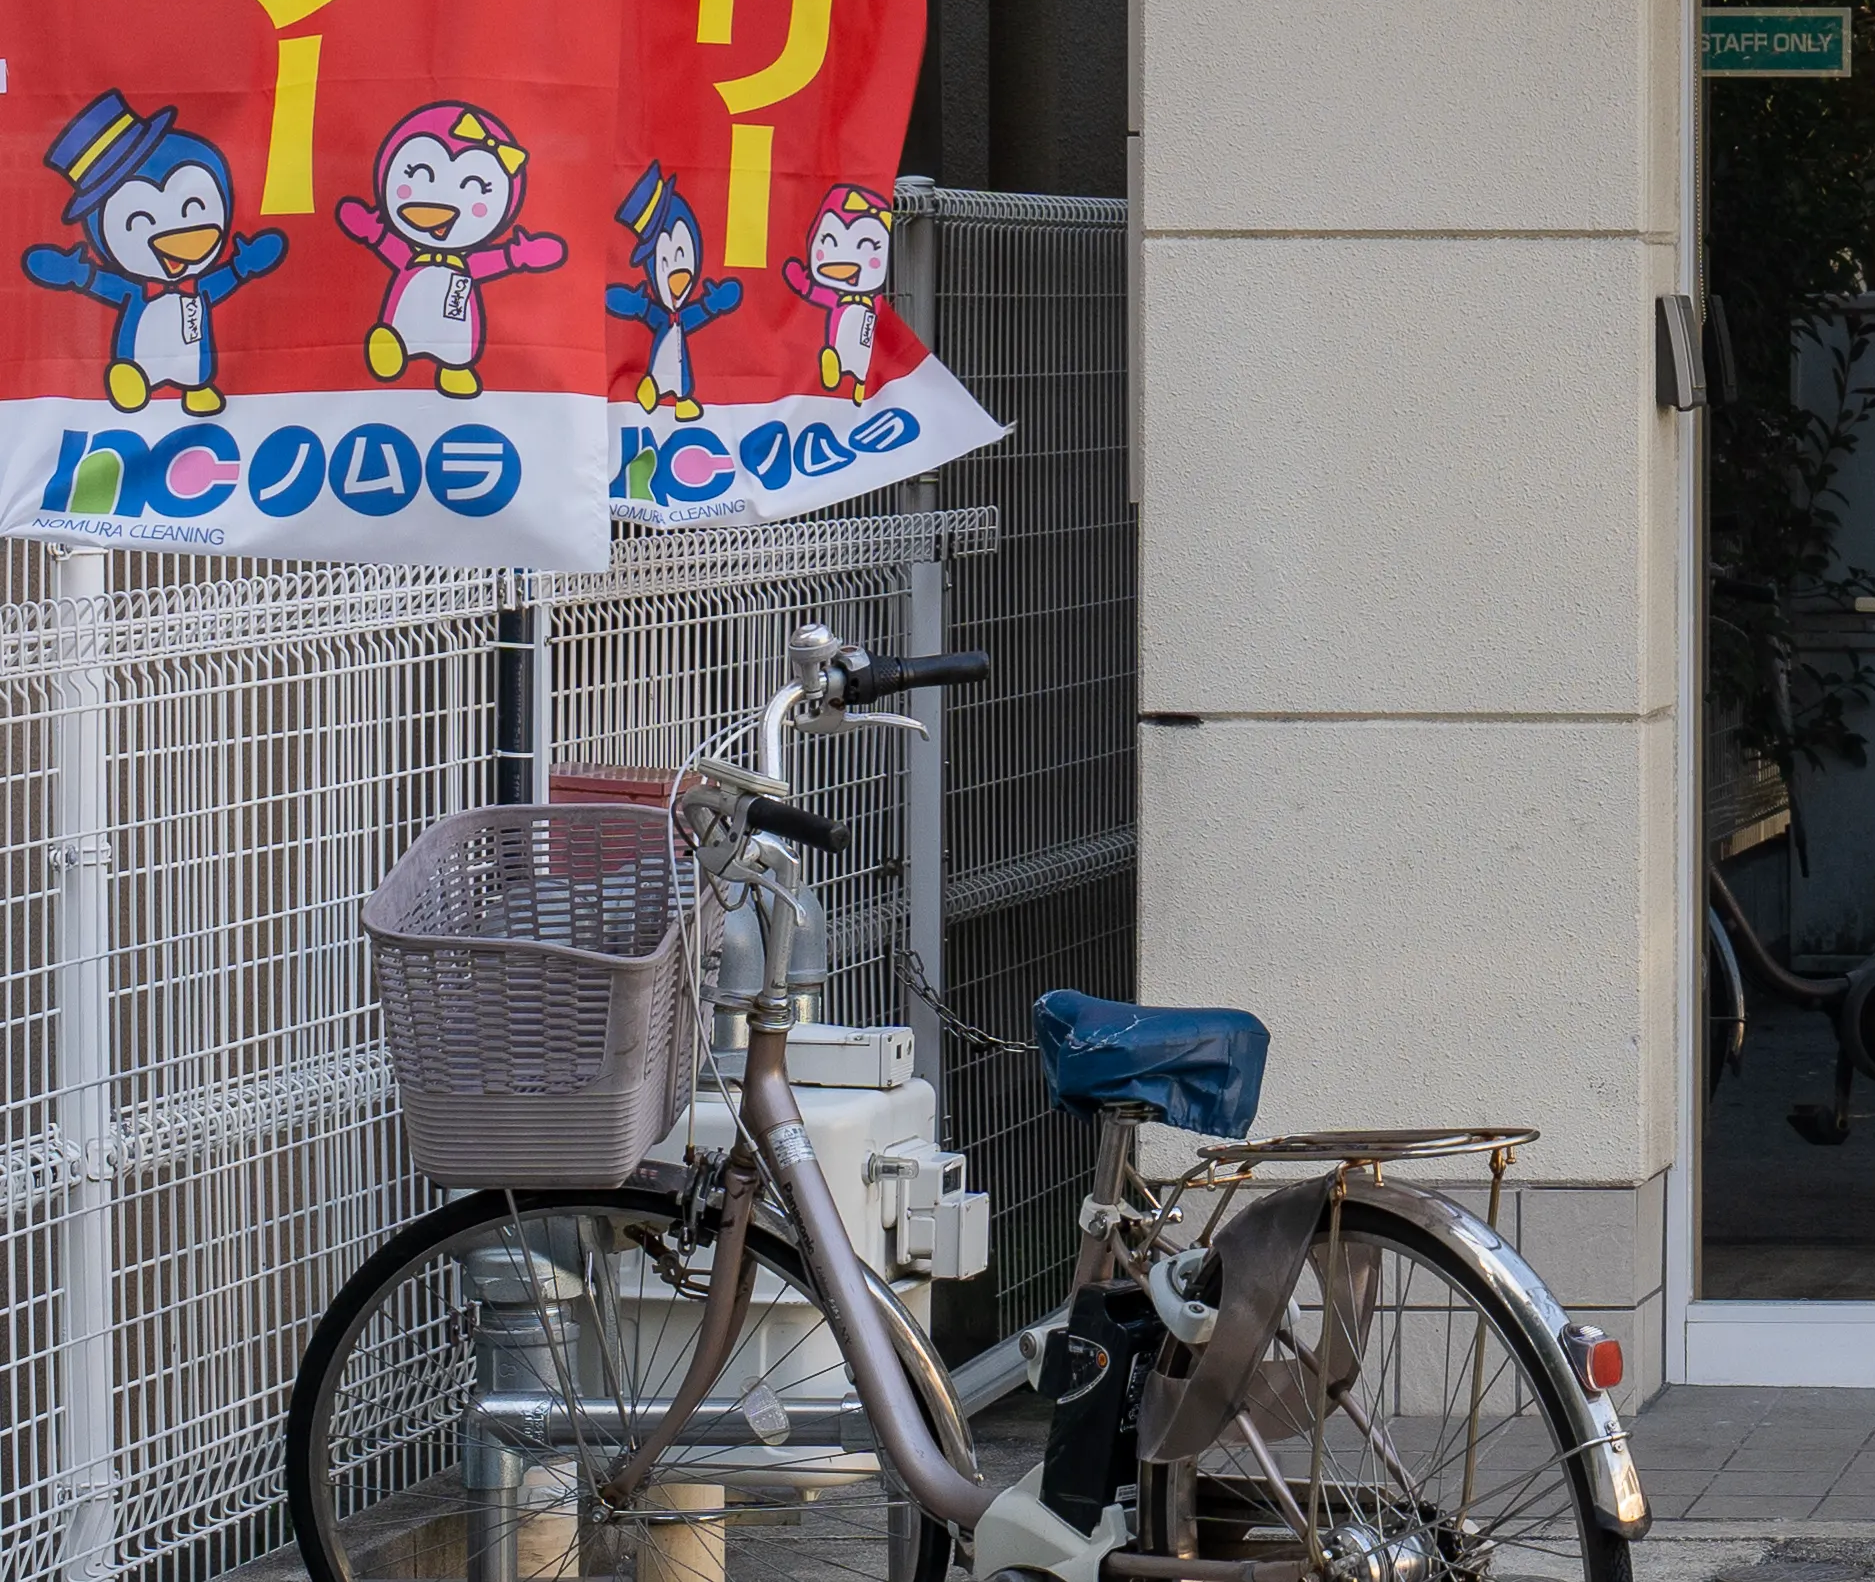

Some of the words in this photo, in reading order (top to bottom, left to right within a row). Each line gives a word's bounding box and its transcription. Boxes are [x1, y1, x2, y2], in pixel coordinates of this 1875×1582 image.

[1698, 33, 1764, 55] STAFF
[1772, 33, 1834, 55] ONLY
[739, 406, 921, 492] ノムラ
[50, 422, 241, 518] nc
[247, 422, 523, 518] ノムラ
[669, 499, 746, 523] CLEANING
[32, 517, 123, 538] NOMURA
[129, 523, 226, 546] CLEANING
